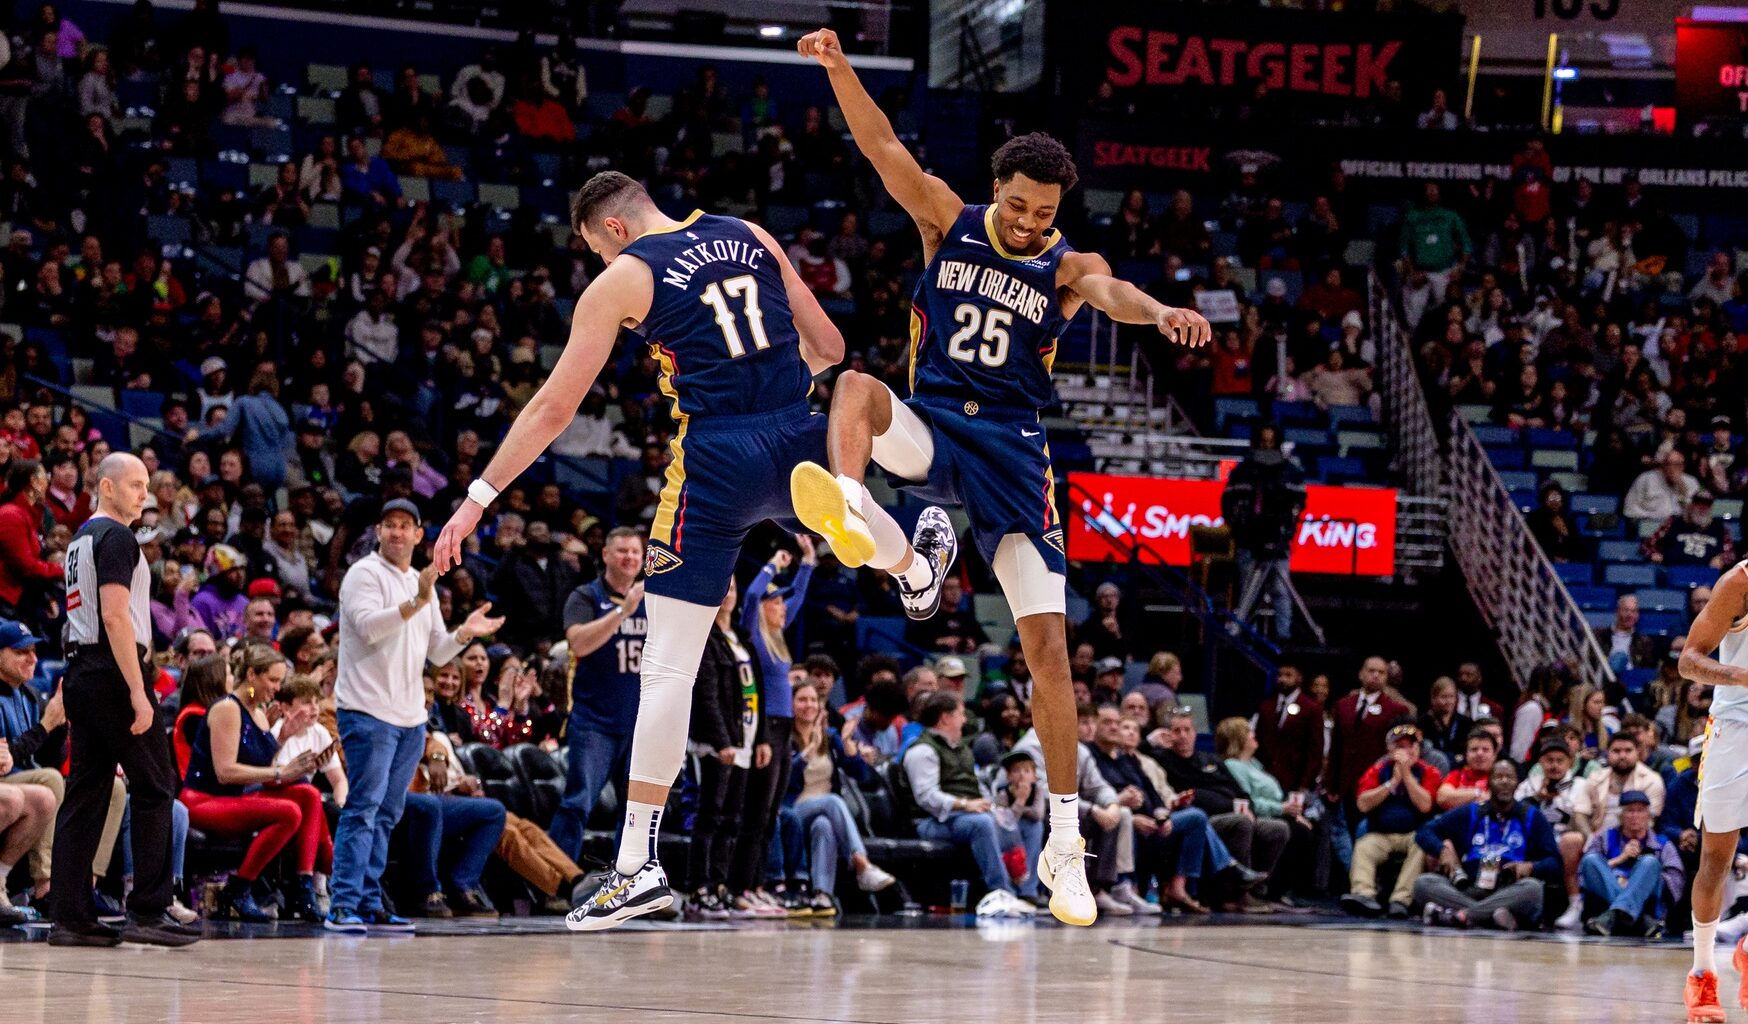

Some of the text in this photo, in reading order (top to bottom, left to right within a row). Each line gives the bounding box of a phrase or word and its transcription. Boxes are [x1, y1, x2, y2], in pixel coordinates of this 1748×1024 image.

[1340, 159, 1402, 178] OFFICIAL
[1406, 161, 1482, 180] TICKETING
[1552, 166, 1572, 183] OF
[1574, 166, 1601, 184] THE
[1638, 168, 1707, 187] ORLEANS
[662, 239, 764, 290] MATKOVIĆ
[699, 274, 771, 359] 17
[936, 260, 1049, 325] NEW ORLEANS
[947, 302, 1014, 368] 25
[67, 545, 80, 588] 32
[615, 638, 642, 674] 15
